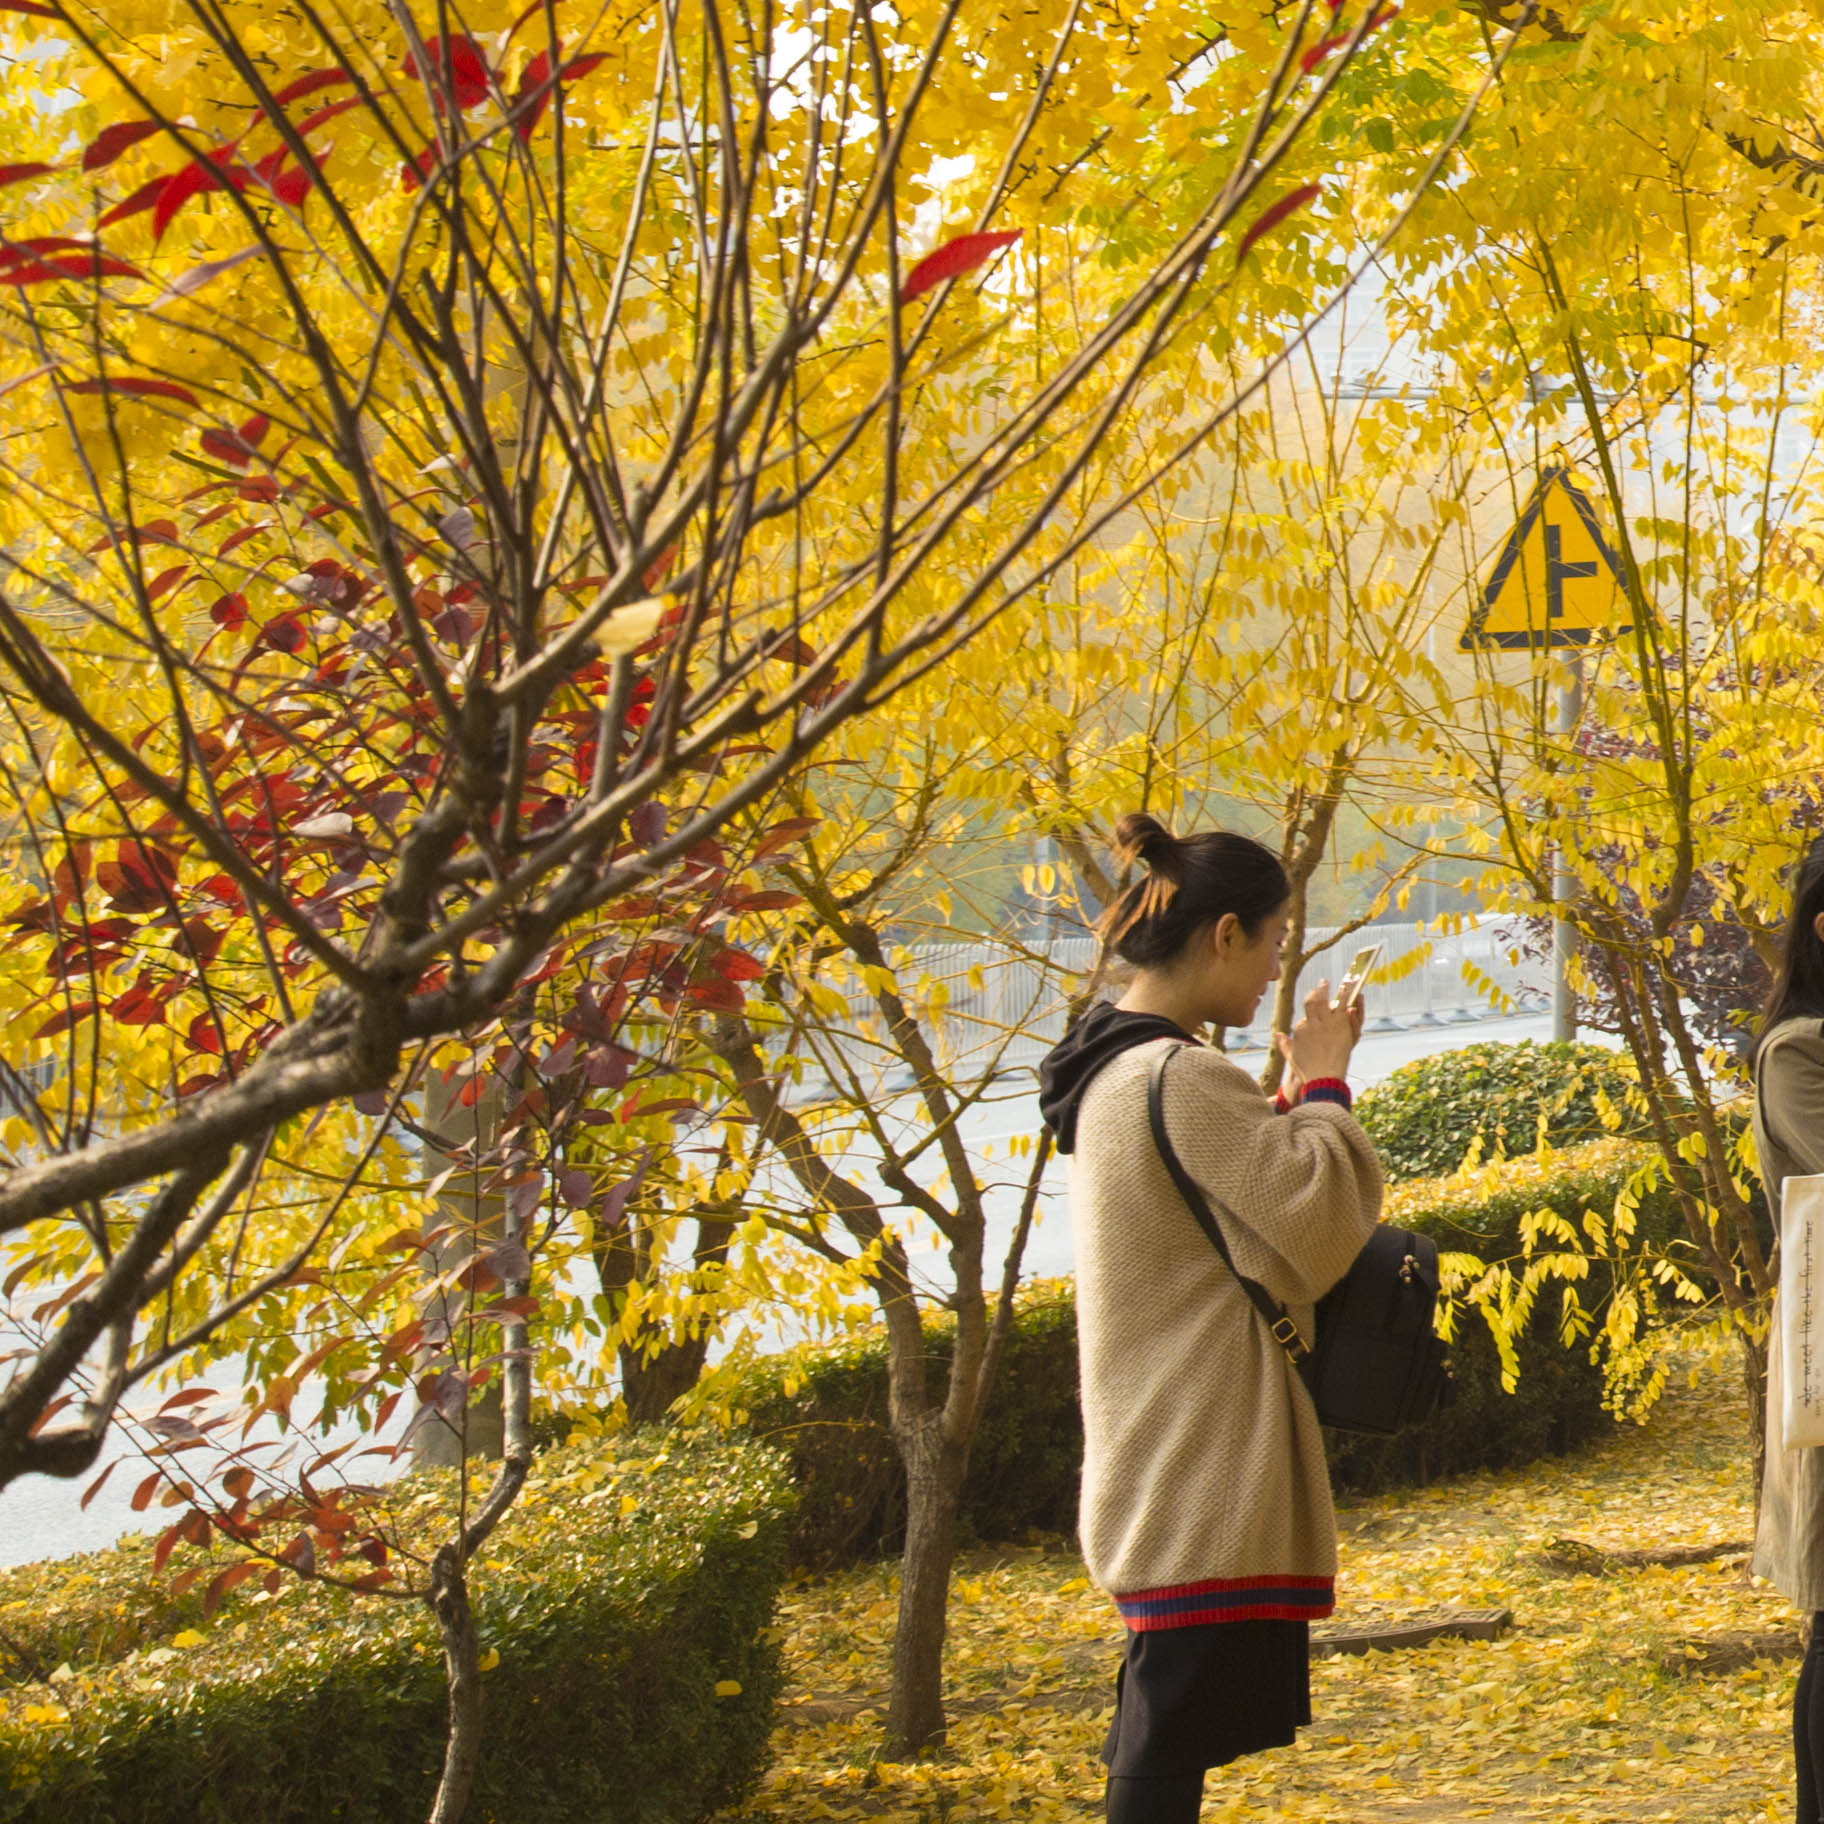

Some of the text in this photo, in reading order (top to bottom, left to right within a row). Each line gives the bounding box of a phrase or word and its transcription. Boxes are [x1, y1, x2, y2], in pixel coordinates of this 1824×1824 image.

[1799, 1284, 1813, 1304] the
[1798, 1310, 1813, 1334] like
[1799, 1344, 1812, 1376] meet
